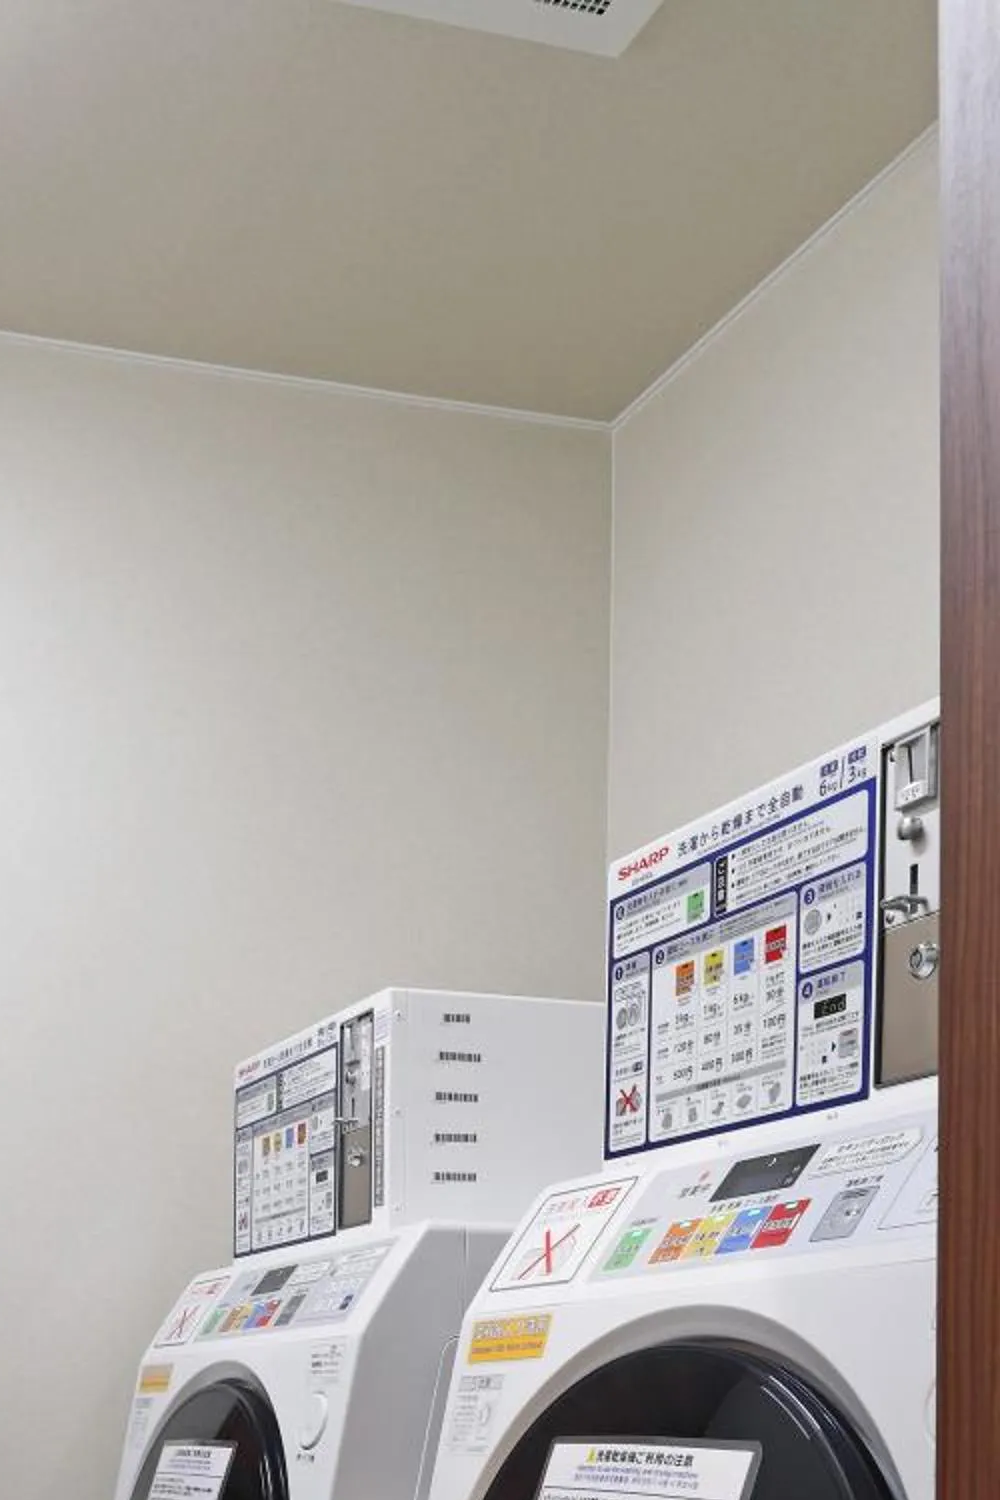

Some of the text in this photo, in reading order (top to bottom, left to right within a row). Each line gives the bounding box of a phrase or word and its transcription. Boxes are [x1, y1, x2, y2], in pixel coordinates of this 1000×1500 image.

[677, 784, 804, 857] 洗濯から乾燥まで全自動
[617, 846, 670, 881] SHARP
